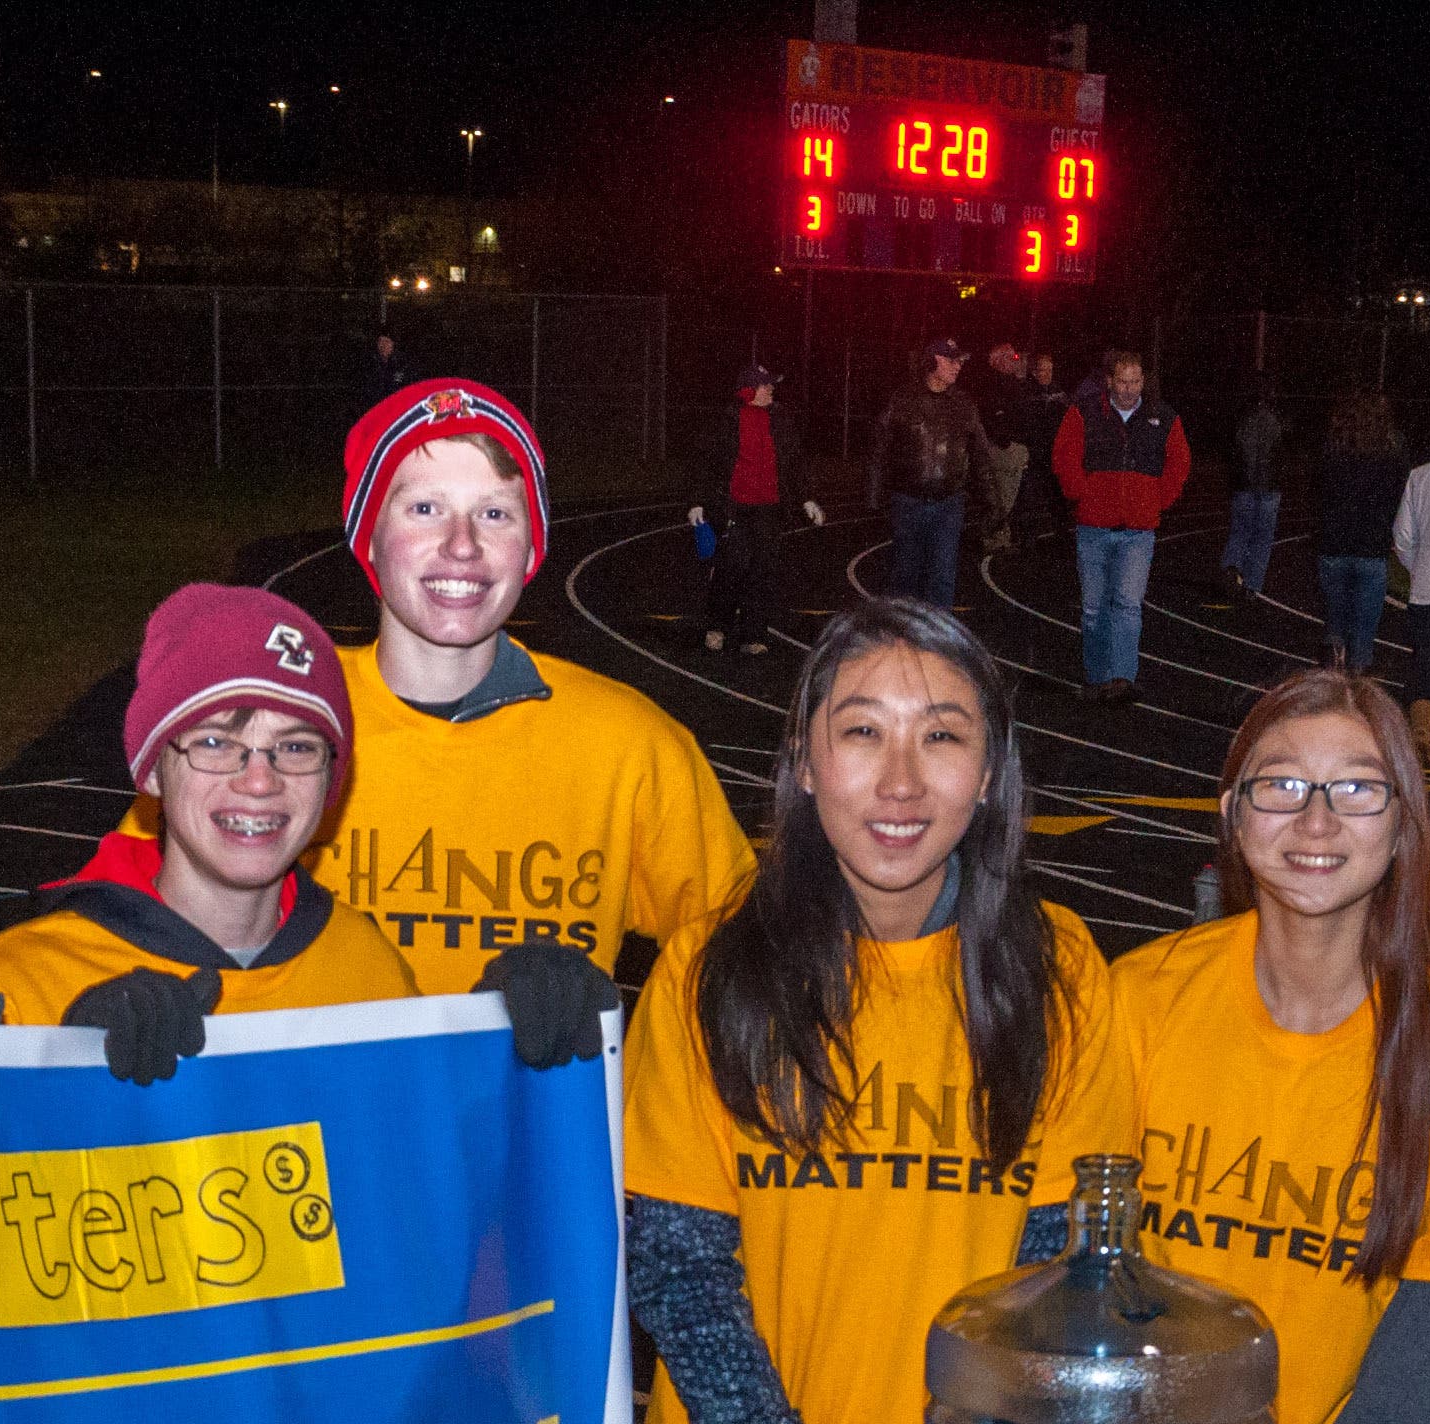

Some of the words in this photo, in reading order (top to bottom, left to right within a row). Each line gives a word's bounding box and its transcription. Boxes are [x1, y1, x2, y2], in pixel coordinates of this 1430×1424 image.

[790, 102, 850, 133] GATORS
[803, 136, 833, 178] 14
[1050, 127, 1099, 152] GUEST
[1058, 157, 1094, 199] 07
[807, 195, 821, 231] 3
[837, 190, 876, 217] DOWN
[893, 195, 909, 219] TO
[919, 198, 936, 220] GO
[955, 200, 983, 225] BALL
[991, 203, 1006, 225] ON
[1065, 214, 1079, 247] 3
[1026, 230, 1042, 273] 3
[361, 910, 597, 953] TTERS
[735, 1151, 1039, 1198] MATTERS
[1140, 1123, 1377, 1229] CHANG
